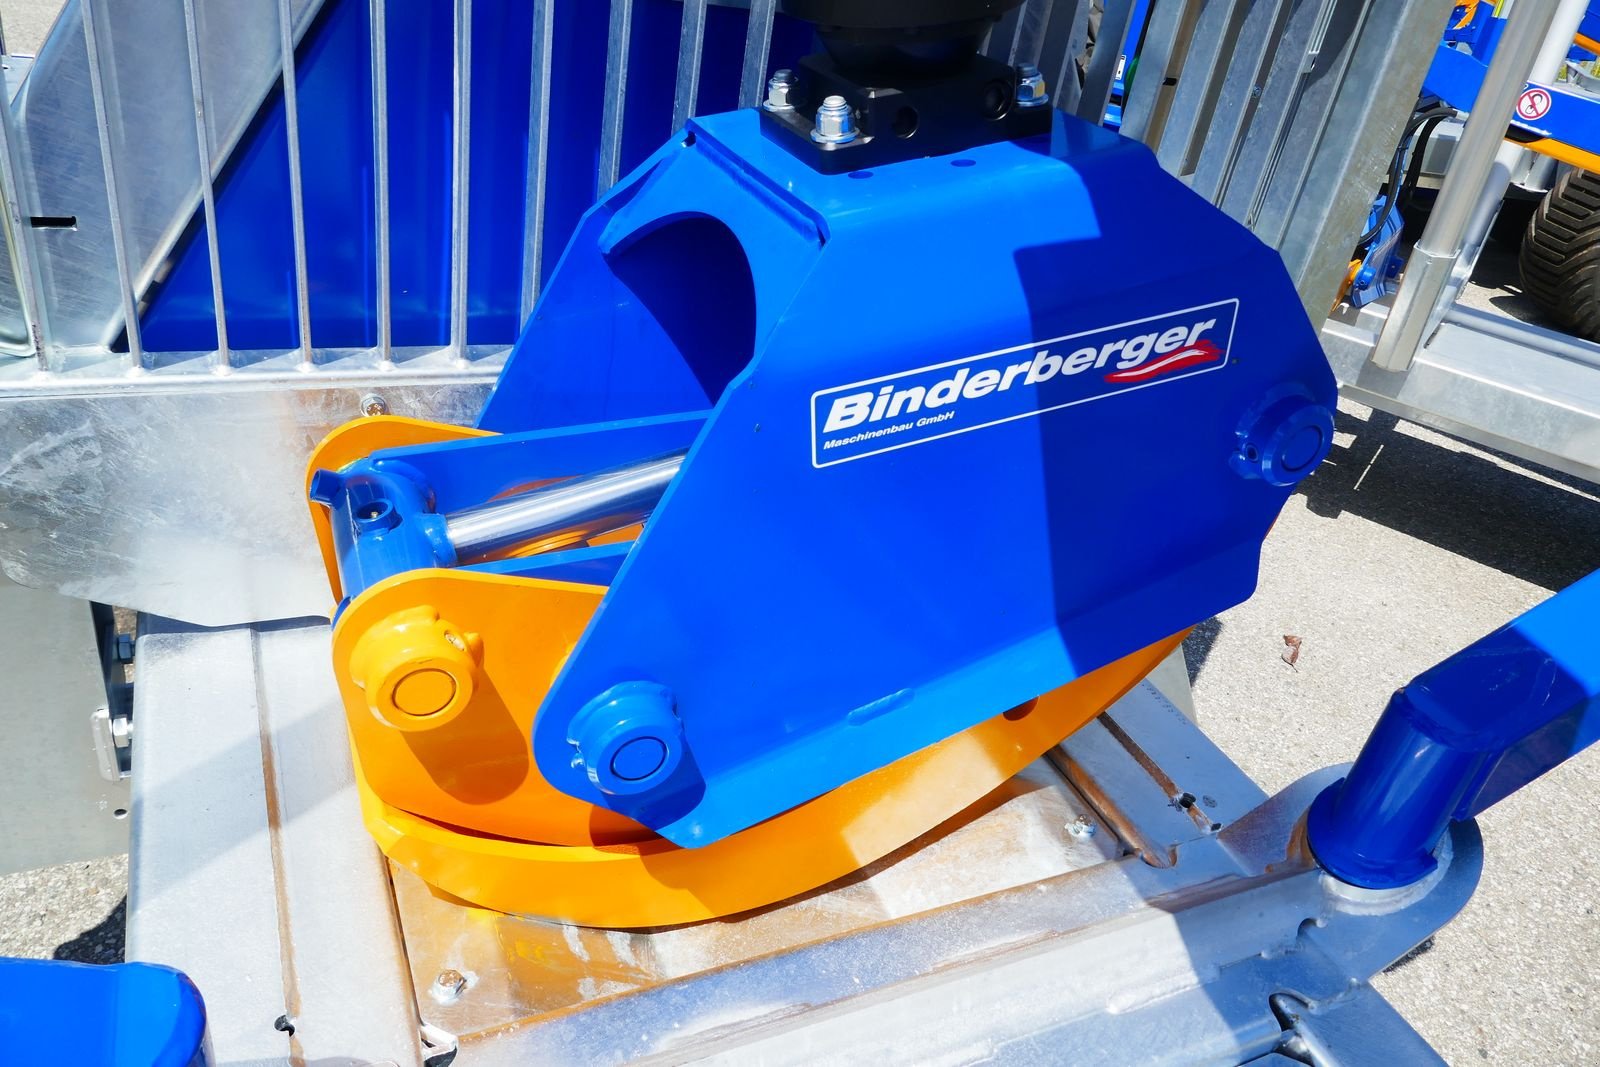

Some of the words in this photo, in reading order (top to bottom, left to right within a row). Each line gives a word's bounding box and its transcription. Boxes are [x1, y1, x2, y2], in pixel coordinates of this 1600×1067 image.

[823, 318, 1216, 433] Binderberger
[823, 422, 914, 450] Maschinenbau
[916, 411, 955, 427] GmbH
